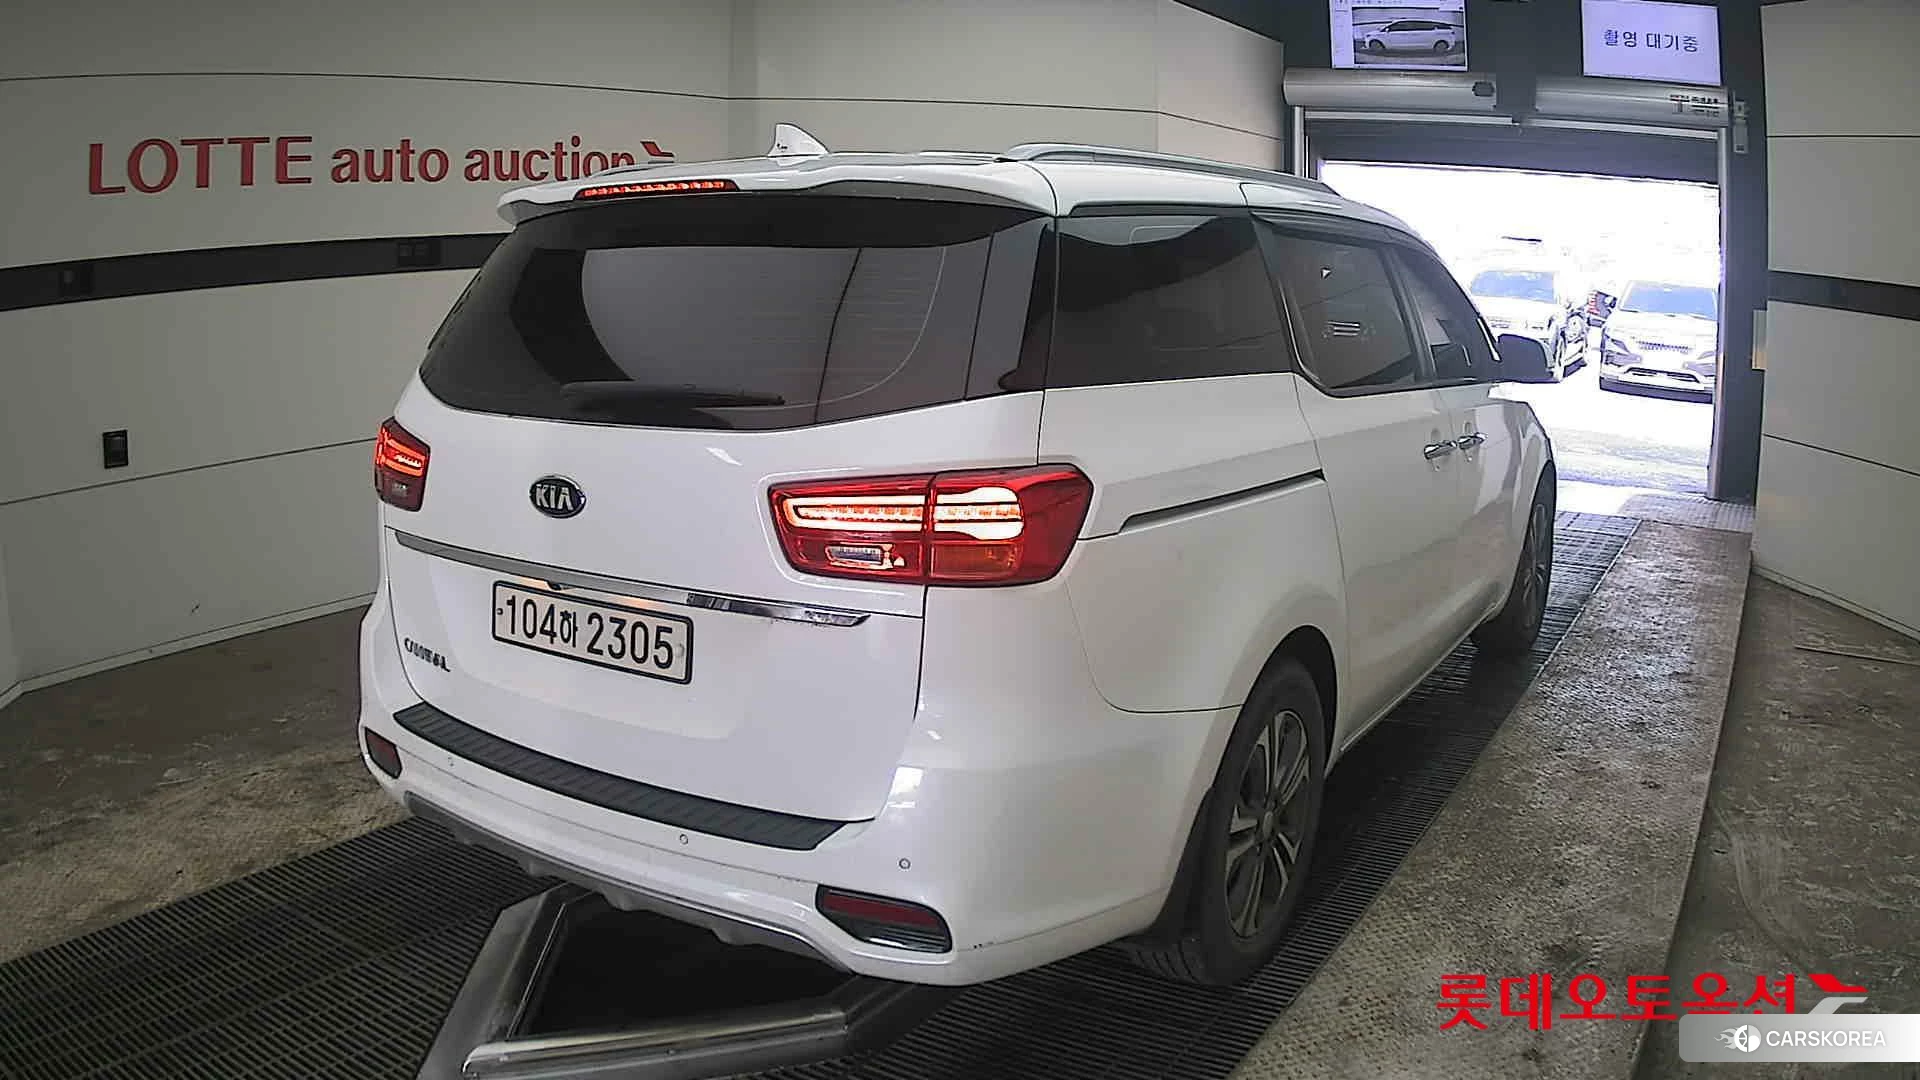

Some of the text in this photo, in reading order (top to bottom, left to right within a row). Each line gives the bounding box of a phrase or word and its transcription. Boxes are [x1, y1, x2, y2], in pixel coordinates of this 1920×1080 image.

[1646, 32, 1698, 53] 대기중
[89, 136, 312, 195] LOTTE
[331, 138, 449, 183] auto
[536, 484, 573, 511] KIA
[506, 595, 673, 670] 104하 2305
